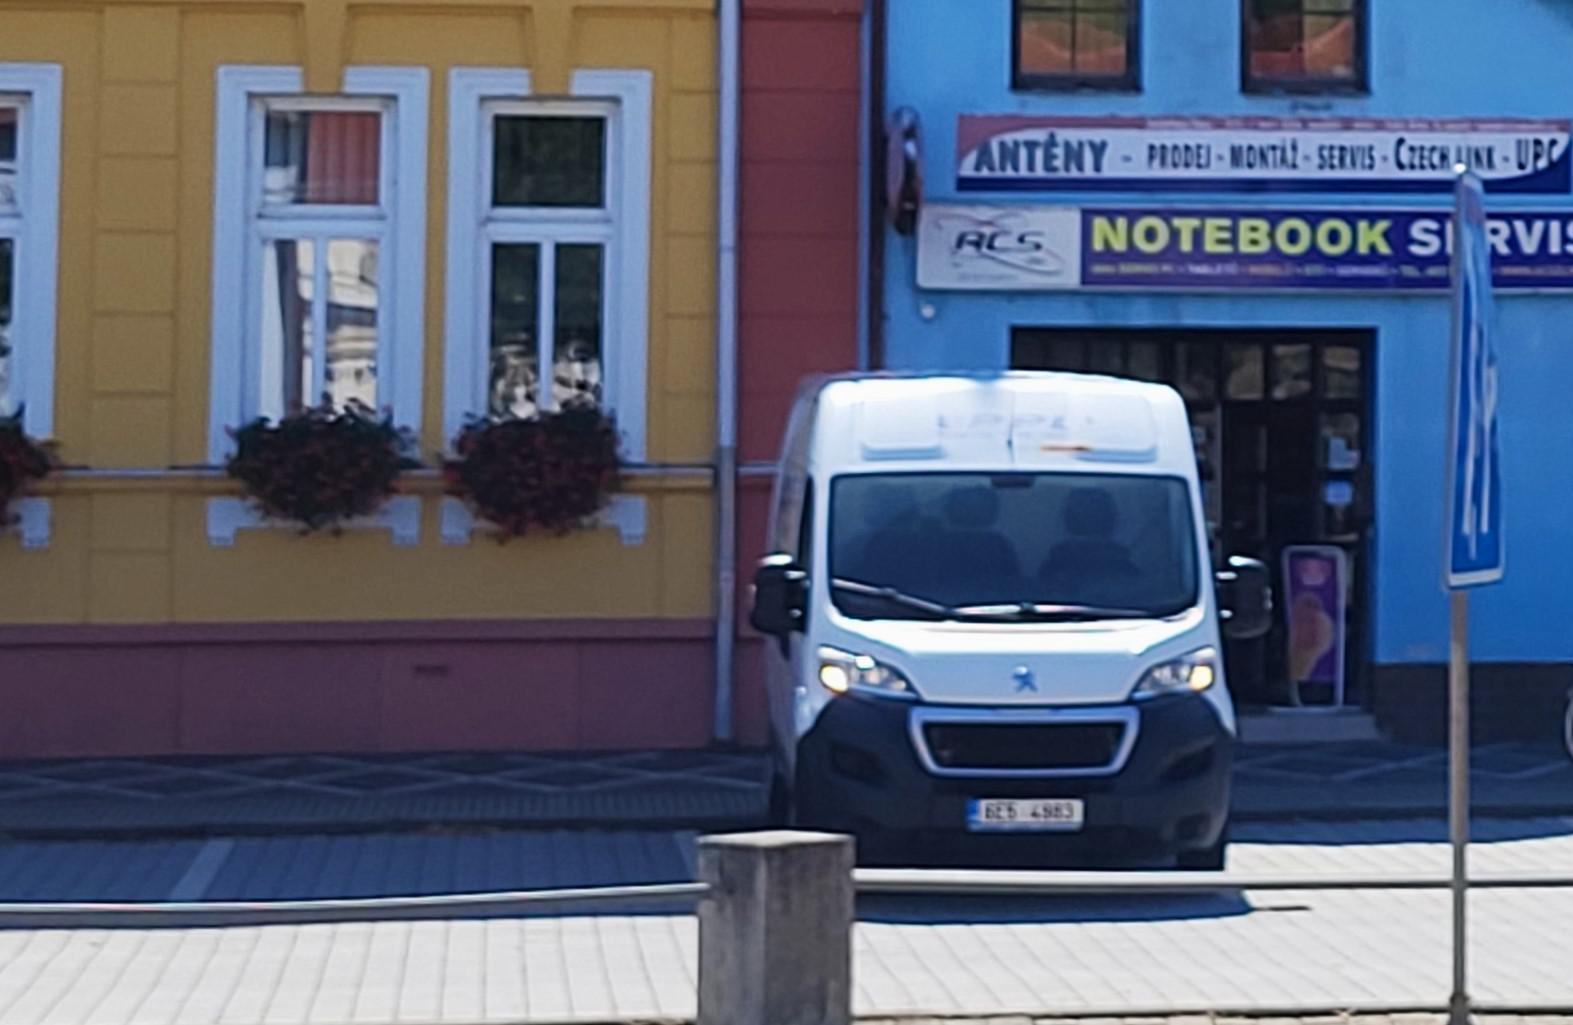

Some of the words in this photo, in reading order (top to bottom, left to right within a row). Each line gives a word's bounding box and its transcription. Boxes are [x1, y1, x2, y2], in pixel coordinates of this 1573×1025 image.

[1147, 142, 1211, 170] PRODEJ
[1317, 143, 1376, 171] SERVIS
[1091, 215, 1393, 256] NOTEBOOK
